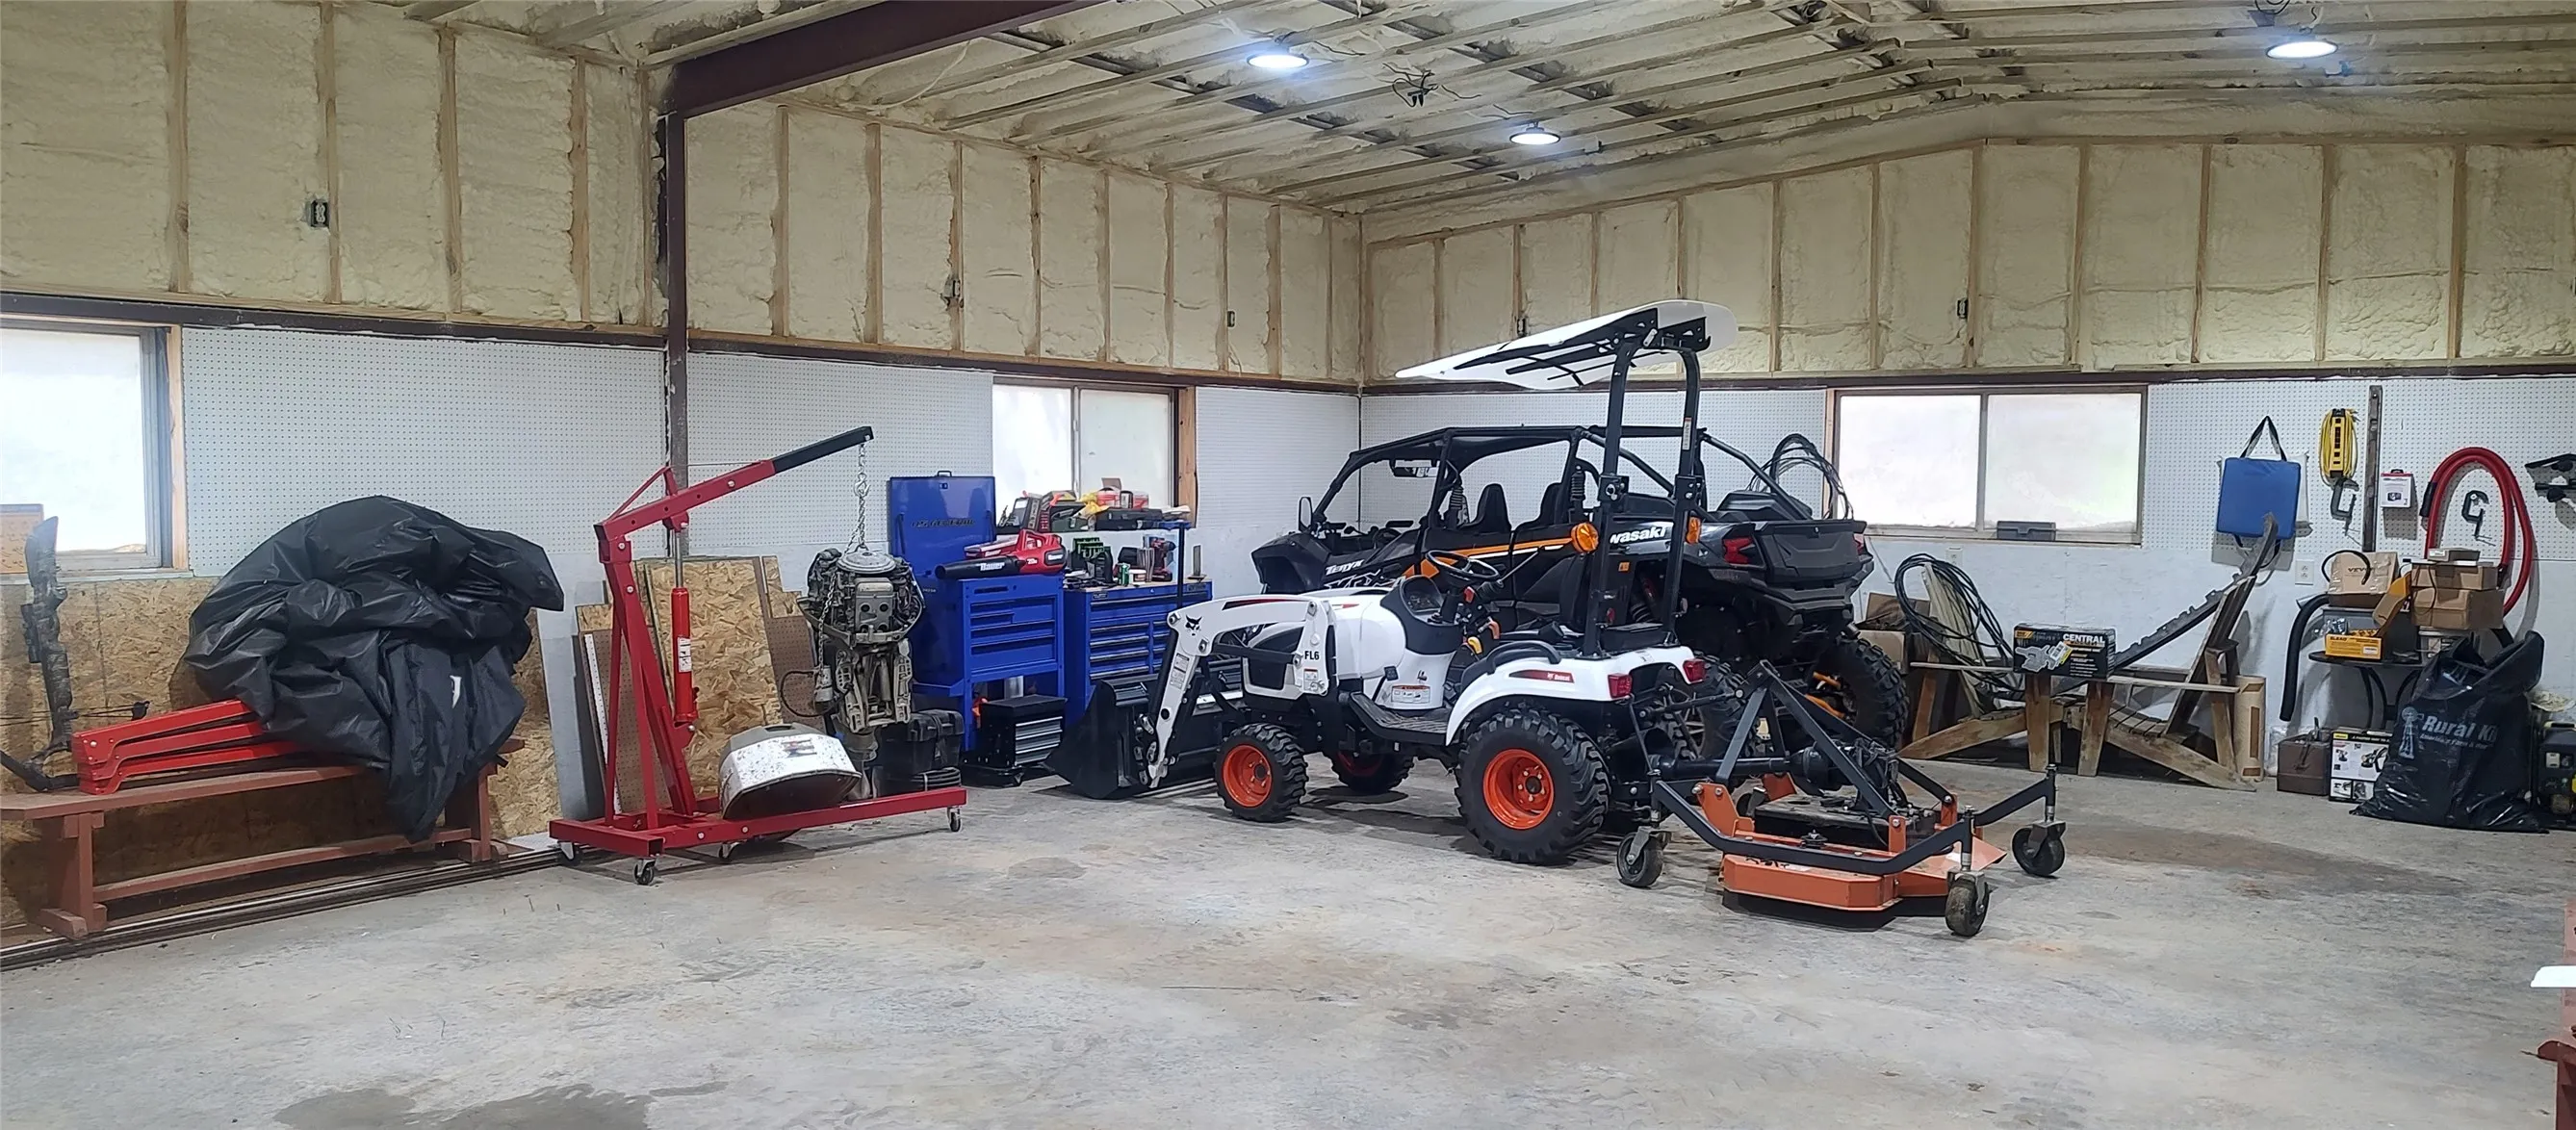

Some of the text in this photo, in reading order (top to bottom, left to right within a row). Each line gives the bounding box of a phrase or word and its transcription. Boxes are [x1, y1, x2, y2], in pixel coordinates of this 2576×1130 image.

[1610, 525, 1668, 545] wasaki
[2062, 633, 2106, 644] CENTRAL
[1304, 650, 1320, 660] FL6
[2422, 715, 2476, 738] Rural
